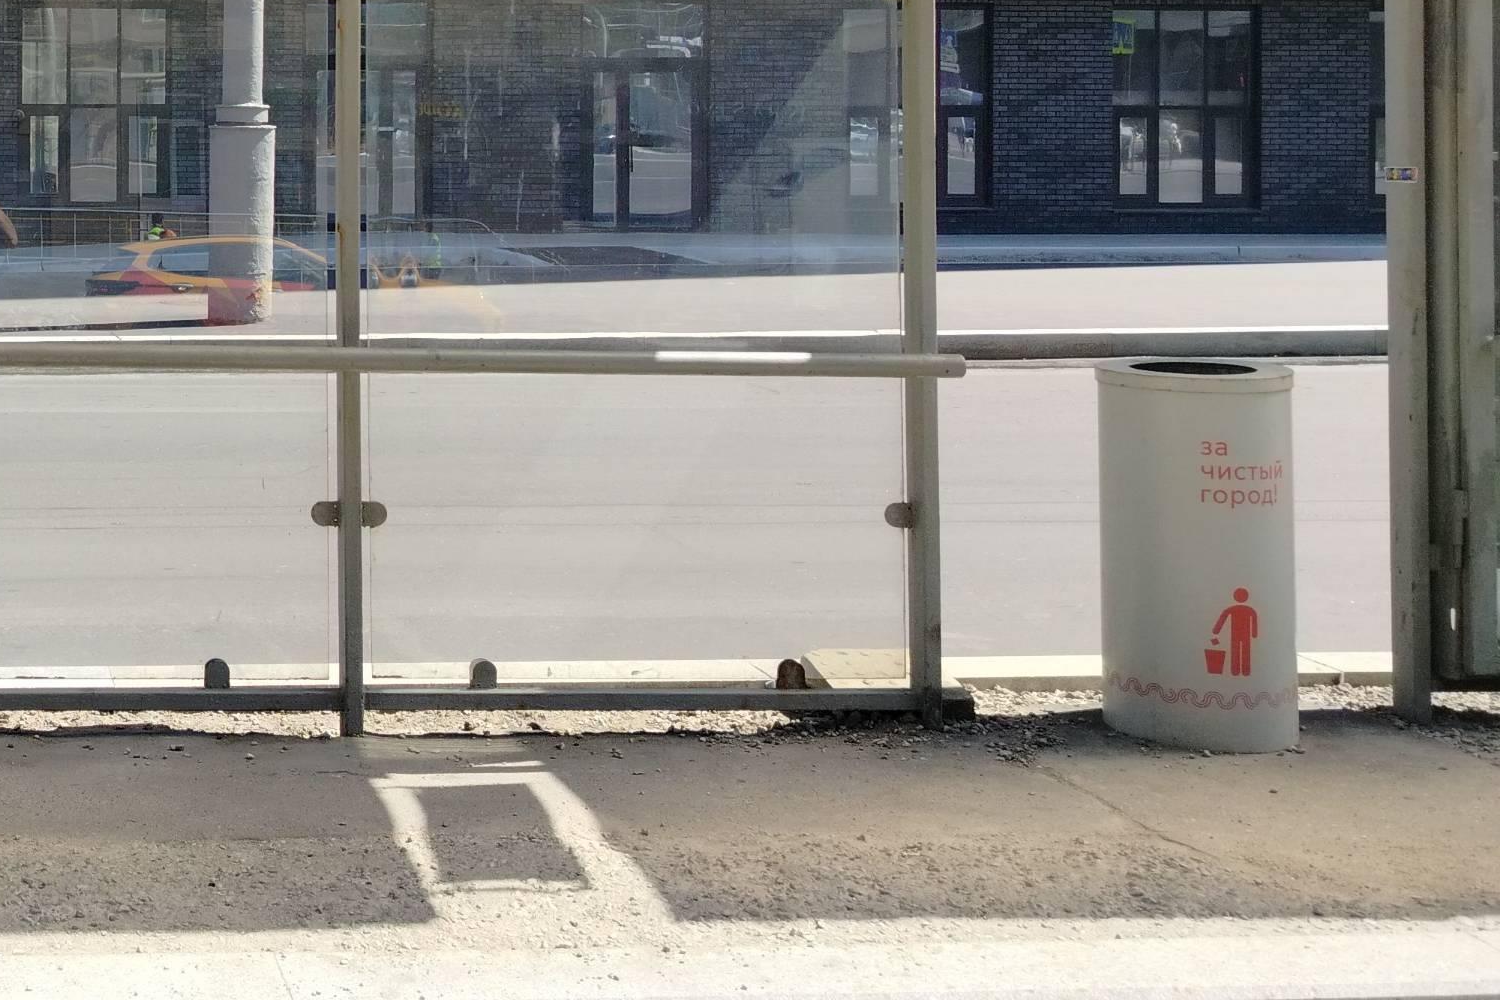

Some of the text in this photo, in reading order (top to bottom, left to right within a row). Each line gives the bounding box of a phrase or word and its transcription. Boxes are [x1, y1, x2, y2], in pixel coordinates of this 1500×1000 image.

[1201, 441, 1228, 456] за
[1201, 460, 1283, 481] чистый
[1201, 485, 1278, 509] город!
